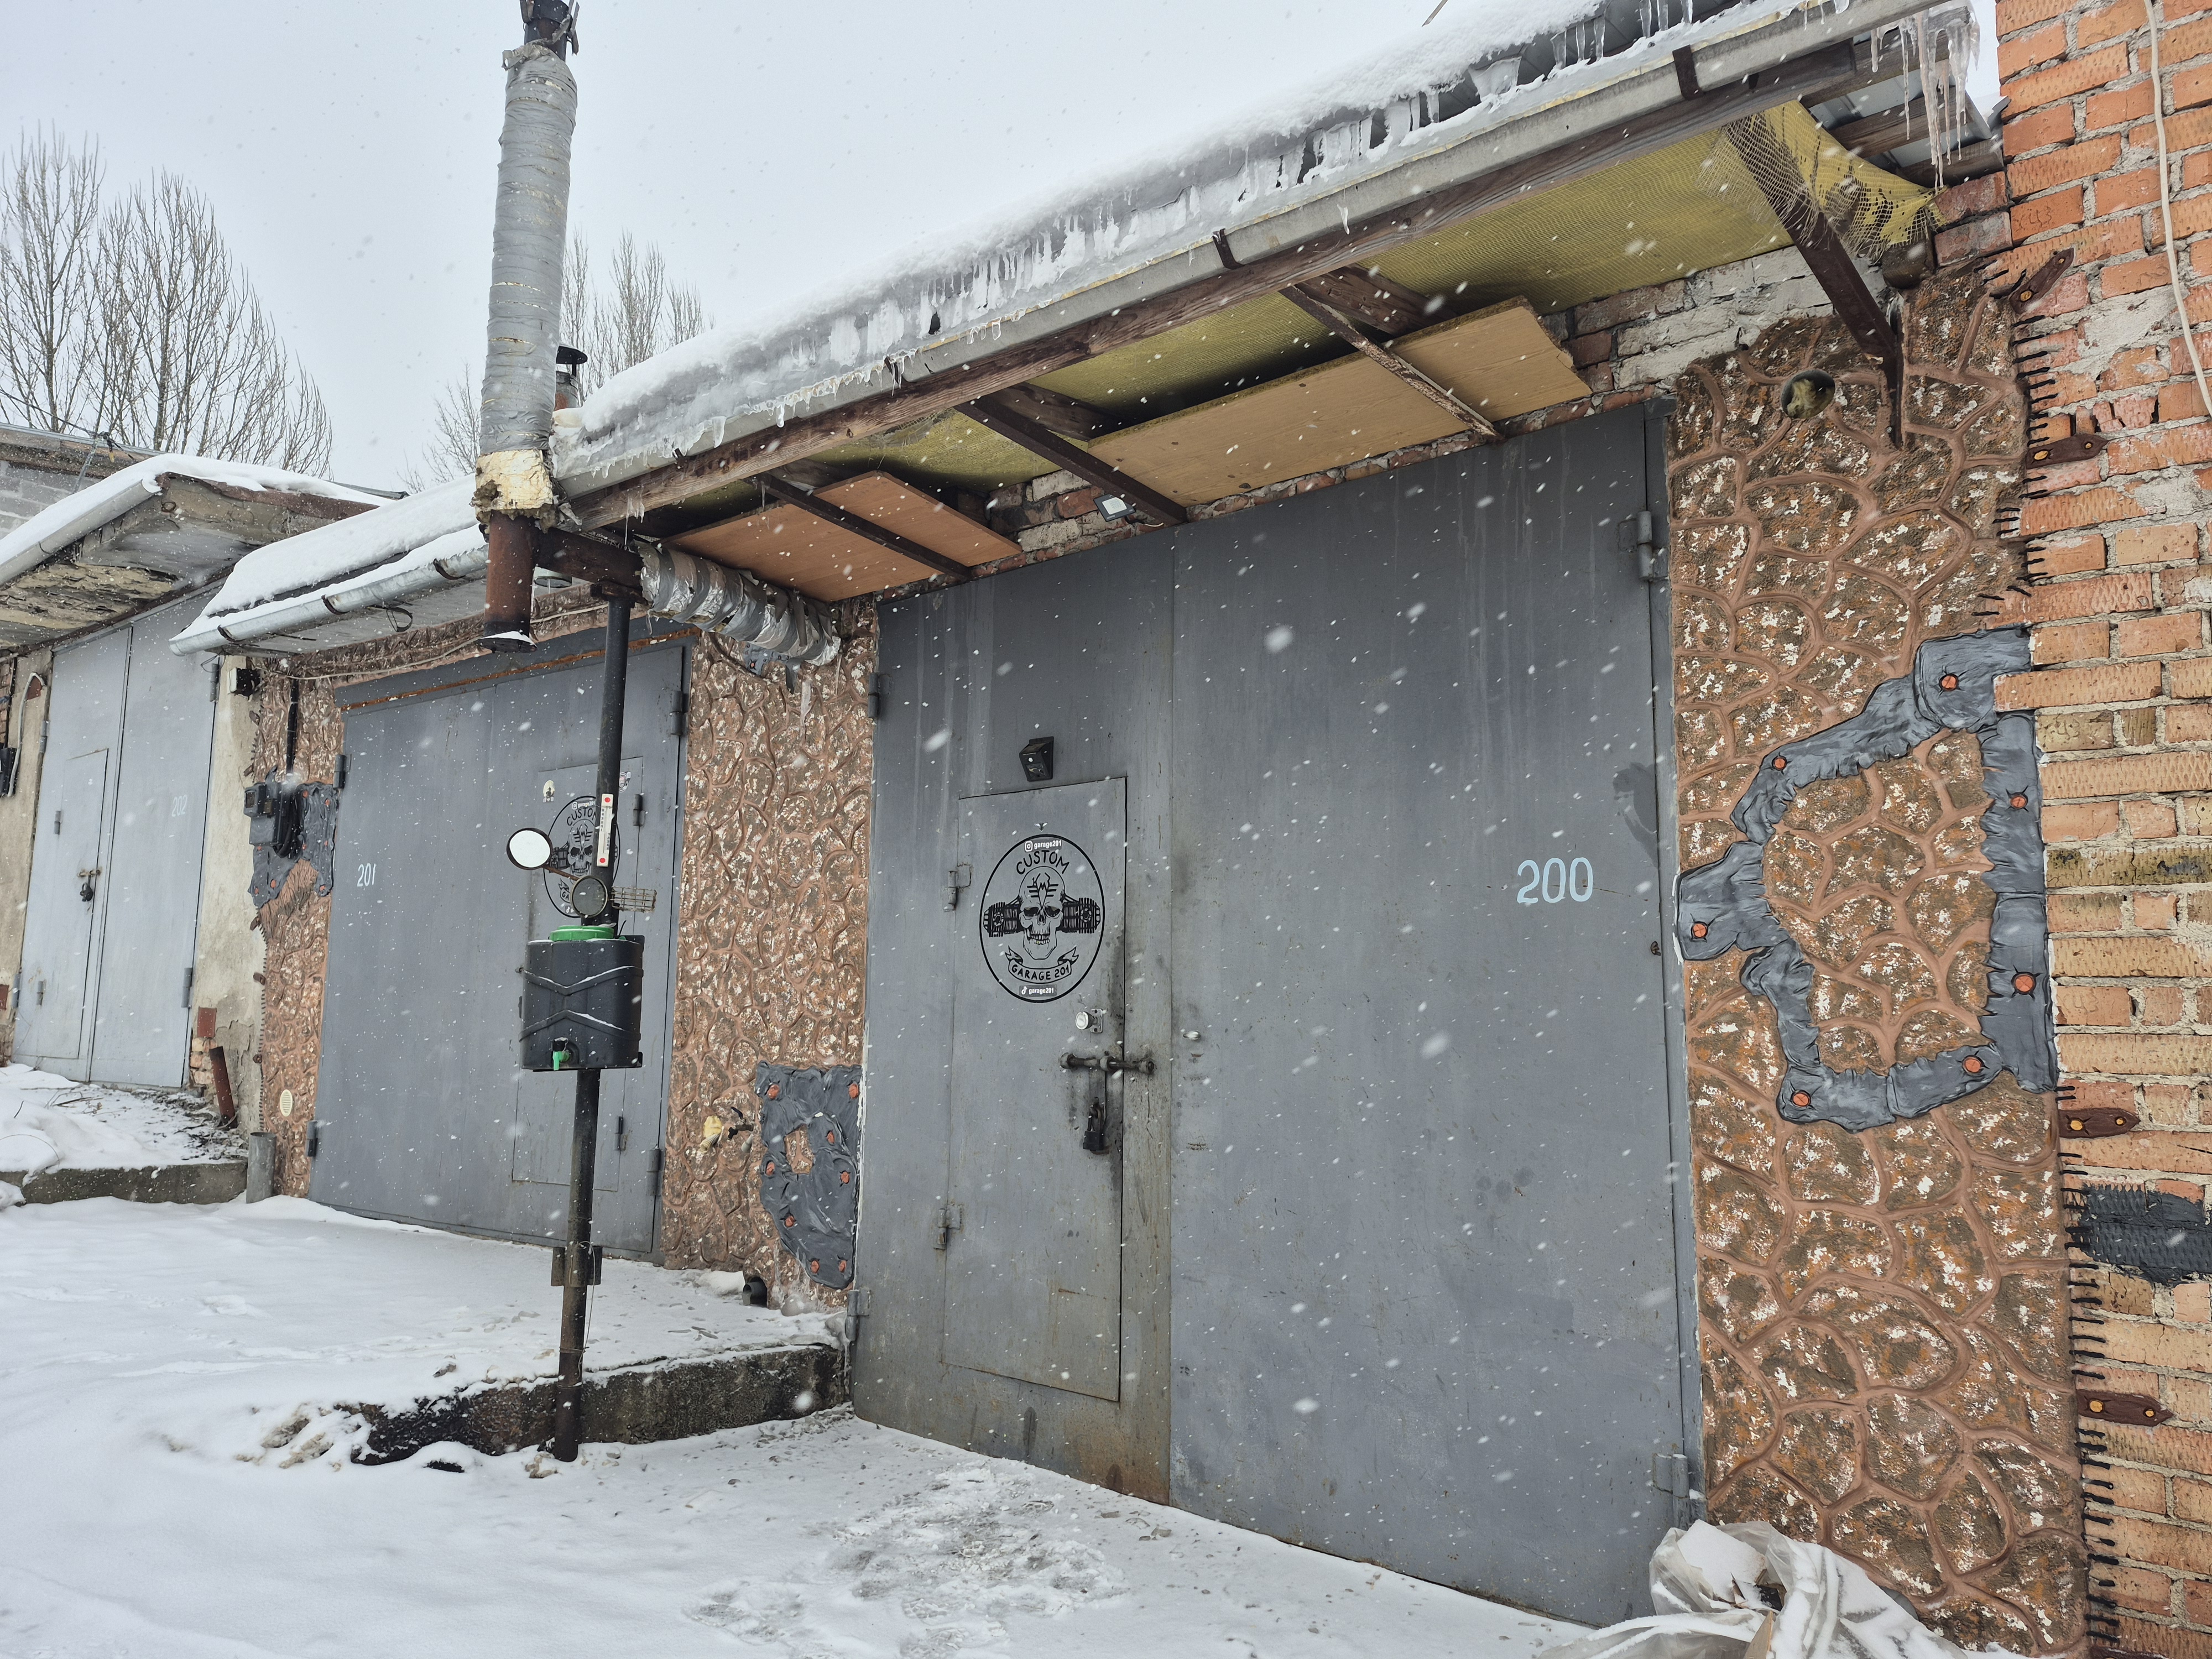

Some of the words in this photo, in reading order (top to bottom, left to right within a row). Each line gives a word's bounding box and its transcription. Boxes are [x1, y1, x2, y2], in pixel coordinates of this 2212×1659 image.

[172, 795, 187, 817] 202
[1034, 839, 1061, 849] garage201
[1016, 850, 1070, 874] CUSTOM
[357, 863, 377, 886] 201
[1517, 857, 1593, 904] 200
[1012, 964, 1051, 980] GARAGE
[1055, 964, 1069, 978] 201
